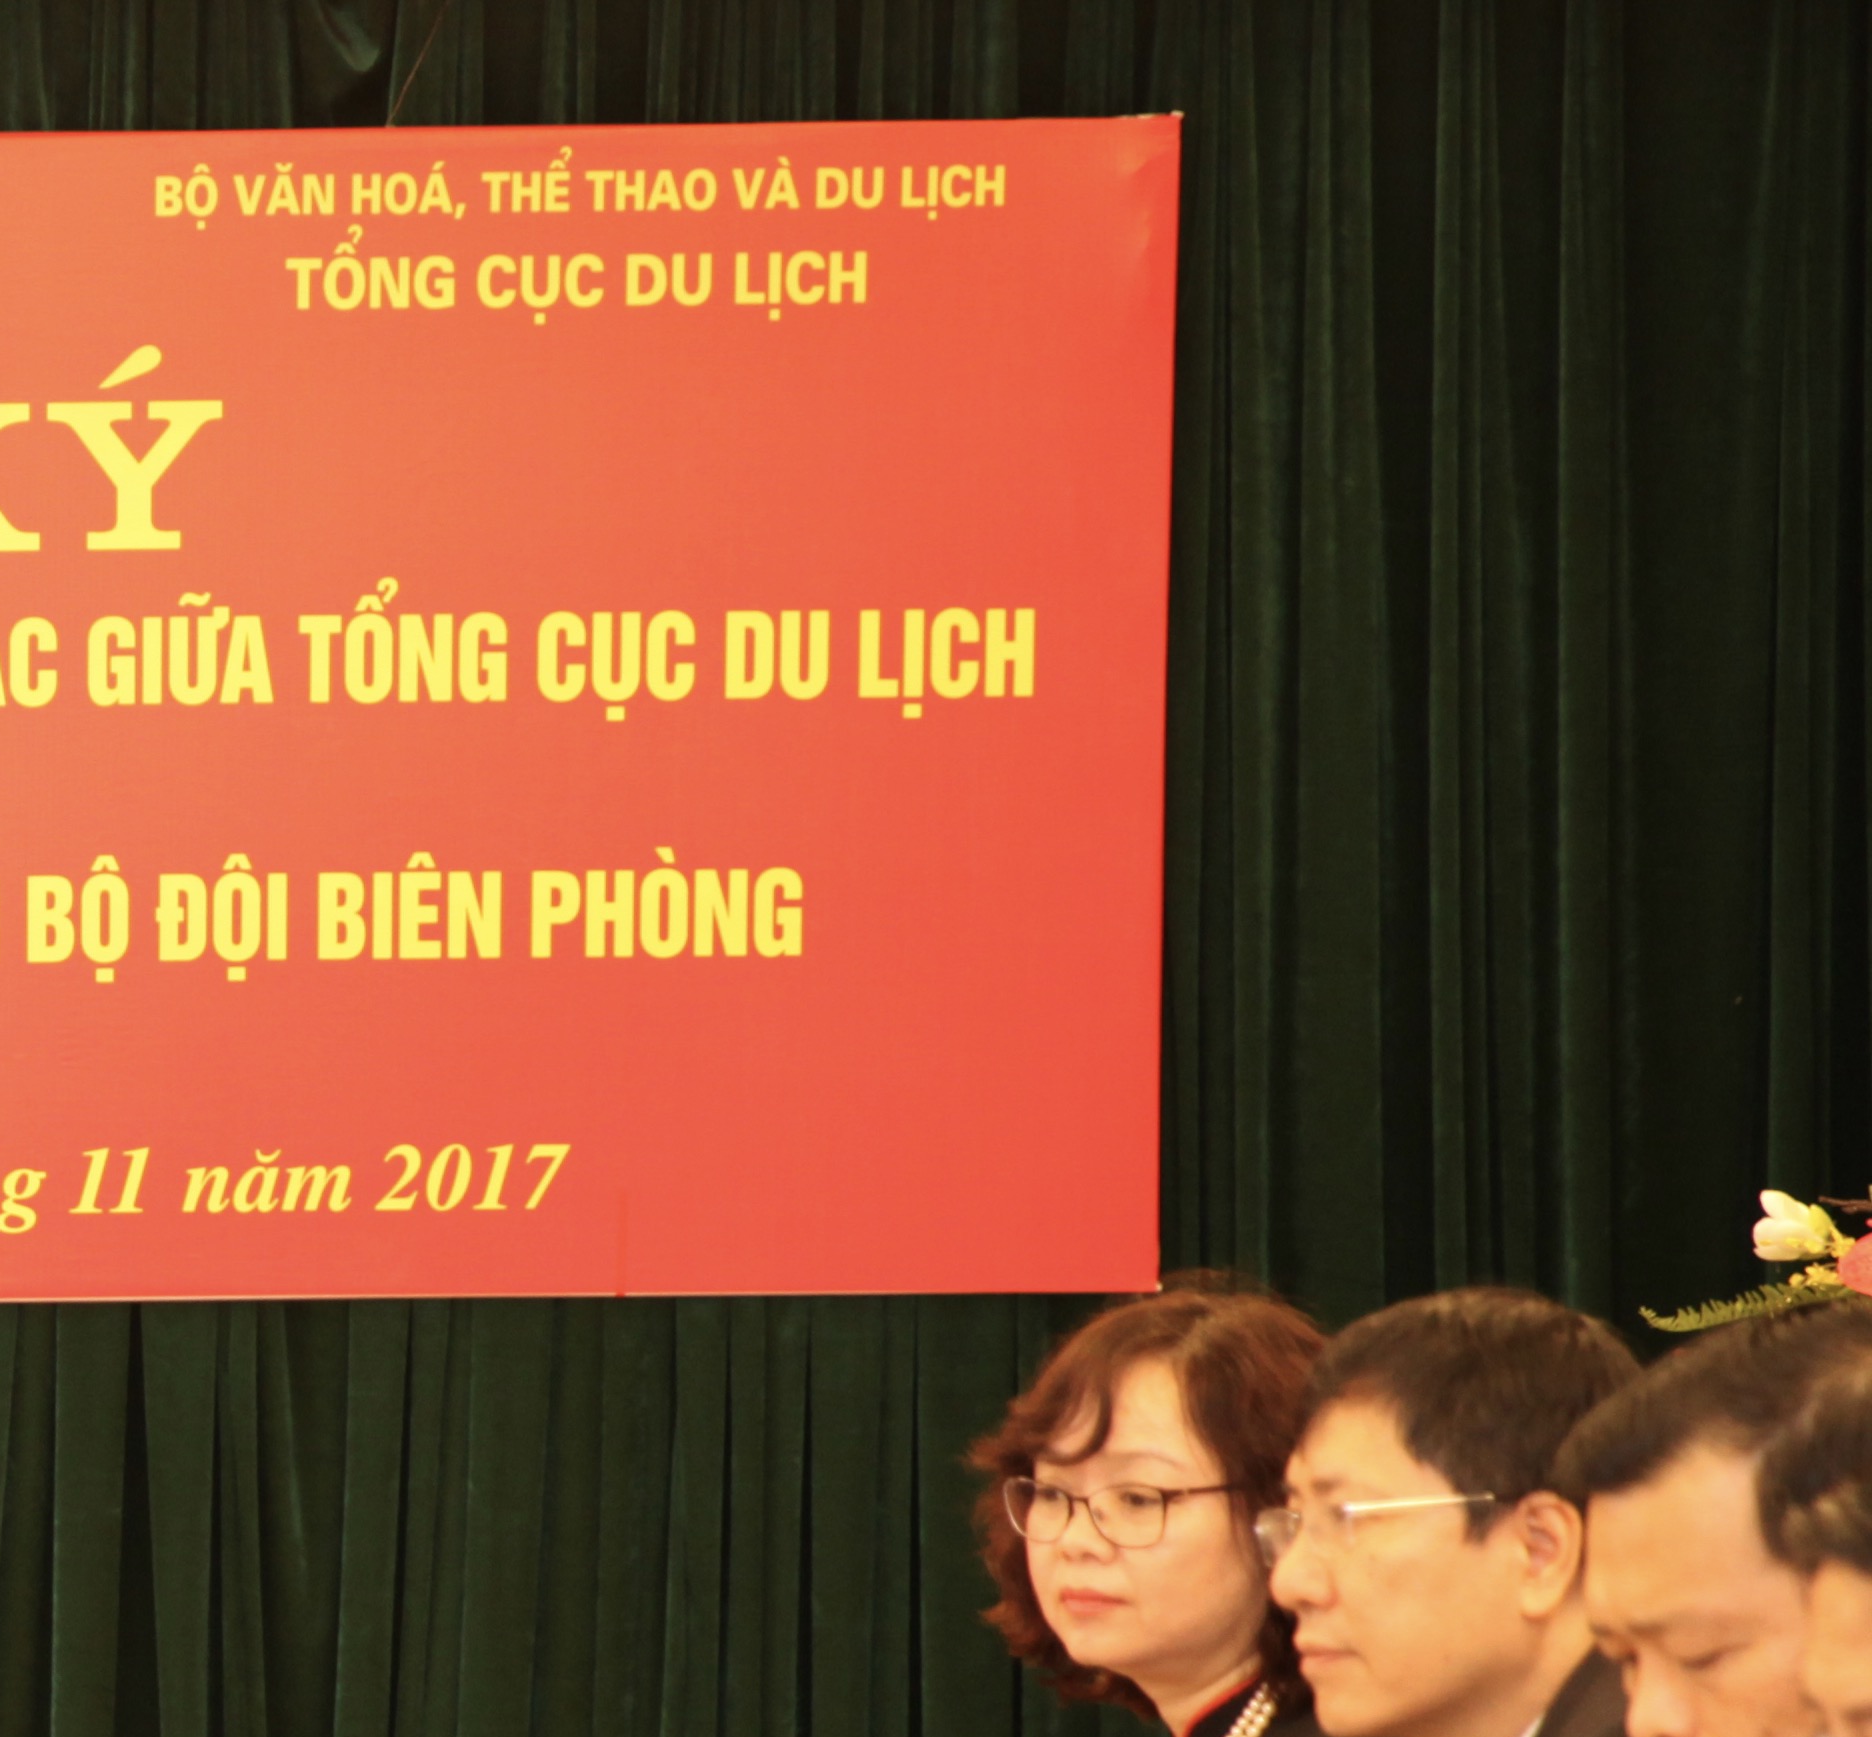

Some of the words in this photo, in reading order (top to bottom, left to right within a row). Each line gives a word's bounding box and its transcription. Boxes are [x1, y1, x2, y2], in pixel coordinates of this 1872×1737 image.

[154, 164, 219, 230] BỘ
[234, 164, 336, 217] VĂN
[350, 162, 466, 220] HOÁ,
[481, 147, 573, 213] THỂ
[586, 170, 718, 212] THAO
[734, 158, 800, 210] VÀ
[817, 168, 885, 209] DU
[903, 166, 1006, 220] LỊCH
[286, 226, 456, 311] TỔNG
[478, 255, 605, 325] CỤC
[627, 254, 713, 307] DU
[736, 252, 868, 321] LỊCH
[88, 592, 274, 707] GIỮA
[300, 577, 508, 704] TỔNG
[538, 612, 696, 721] CỤC
[726, 612, 830, 700] DU
[860, 609, 1035, 718] LỊCH
[27, 856, 130, 983] BỘ
[157, 855, 288, 982] ĐỘI
[318, 853, 502, 960] BIÊN
[532, 849, 803, 958] PHÒNG
[71, 1149, 149, 1214] 11
[184, 1151, 351, 1214] năm
[377, 1145, 570, 1212] 2017
